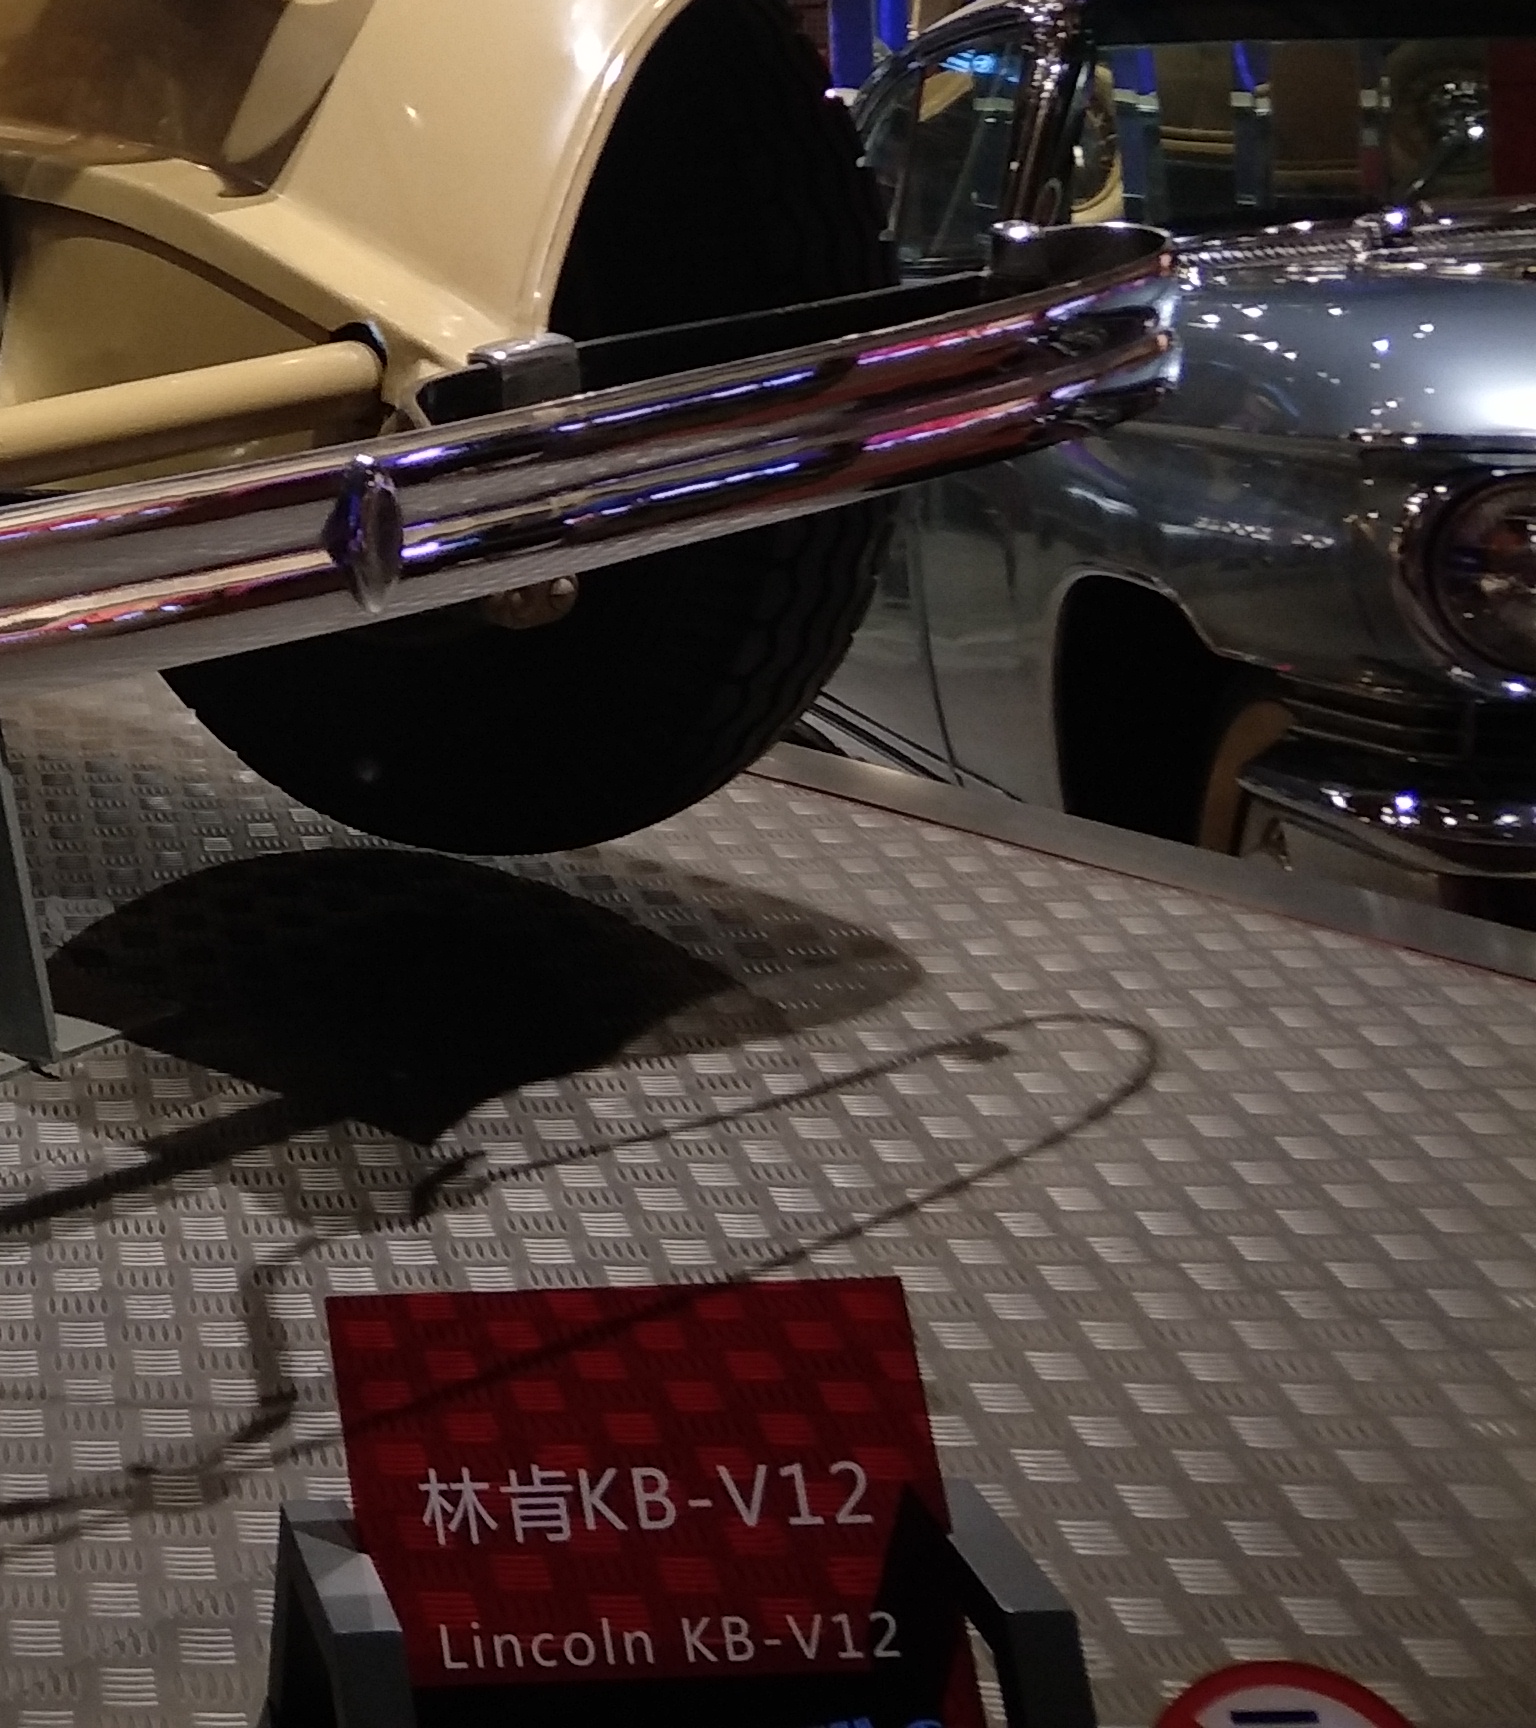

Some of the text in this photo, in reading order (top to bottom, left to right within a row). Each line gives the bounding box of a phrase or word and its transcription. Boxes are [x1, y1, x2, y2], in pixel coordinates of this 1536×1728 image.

[418, 1460, 875, 1546] 林肯KB-V12
[439, 1611, 903, 1671] Lincoln KB-V12
